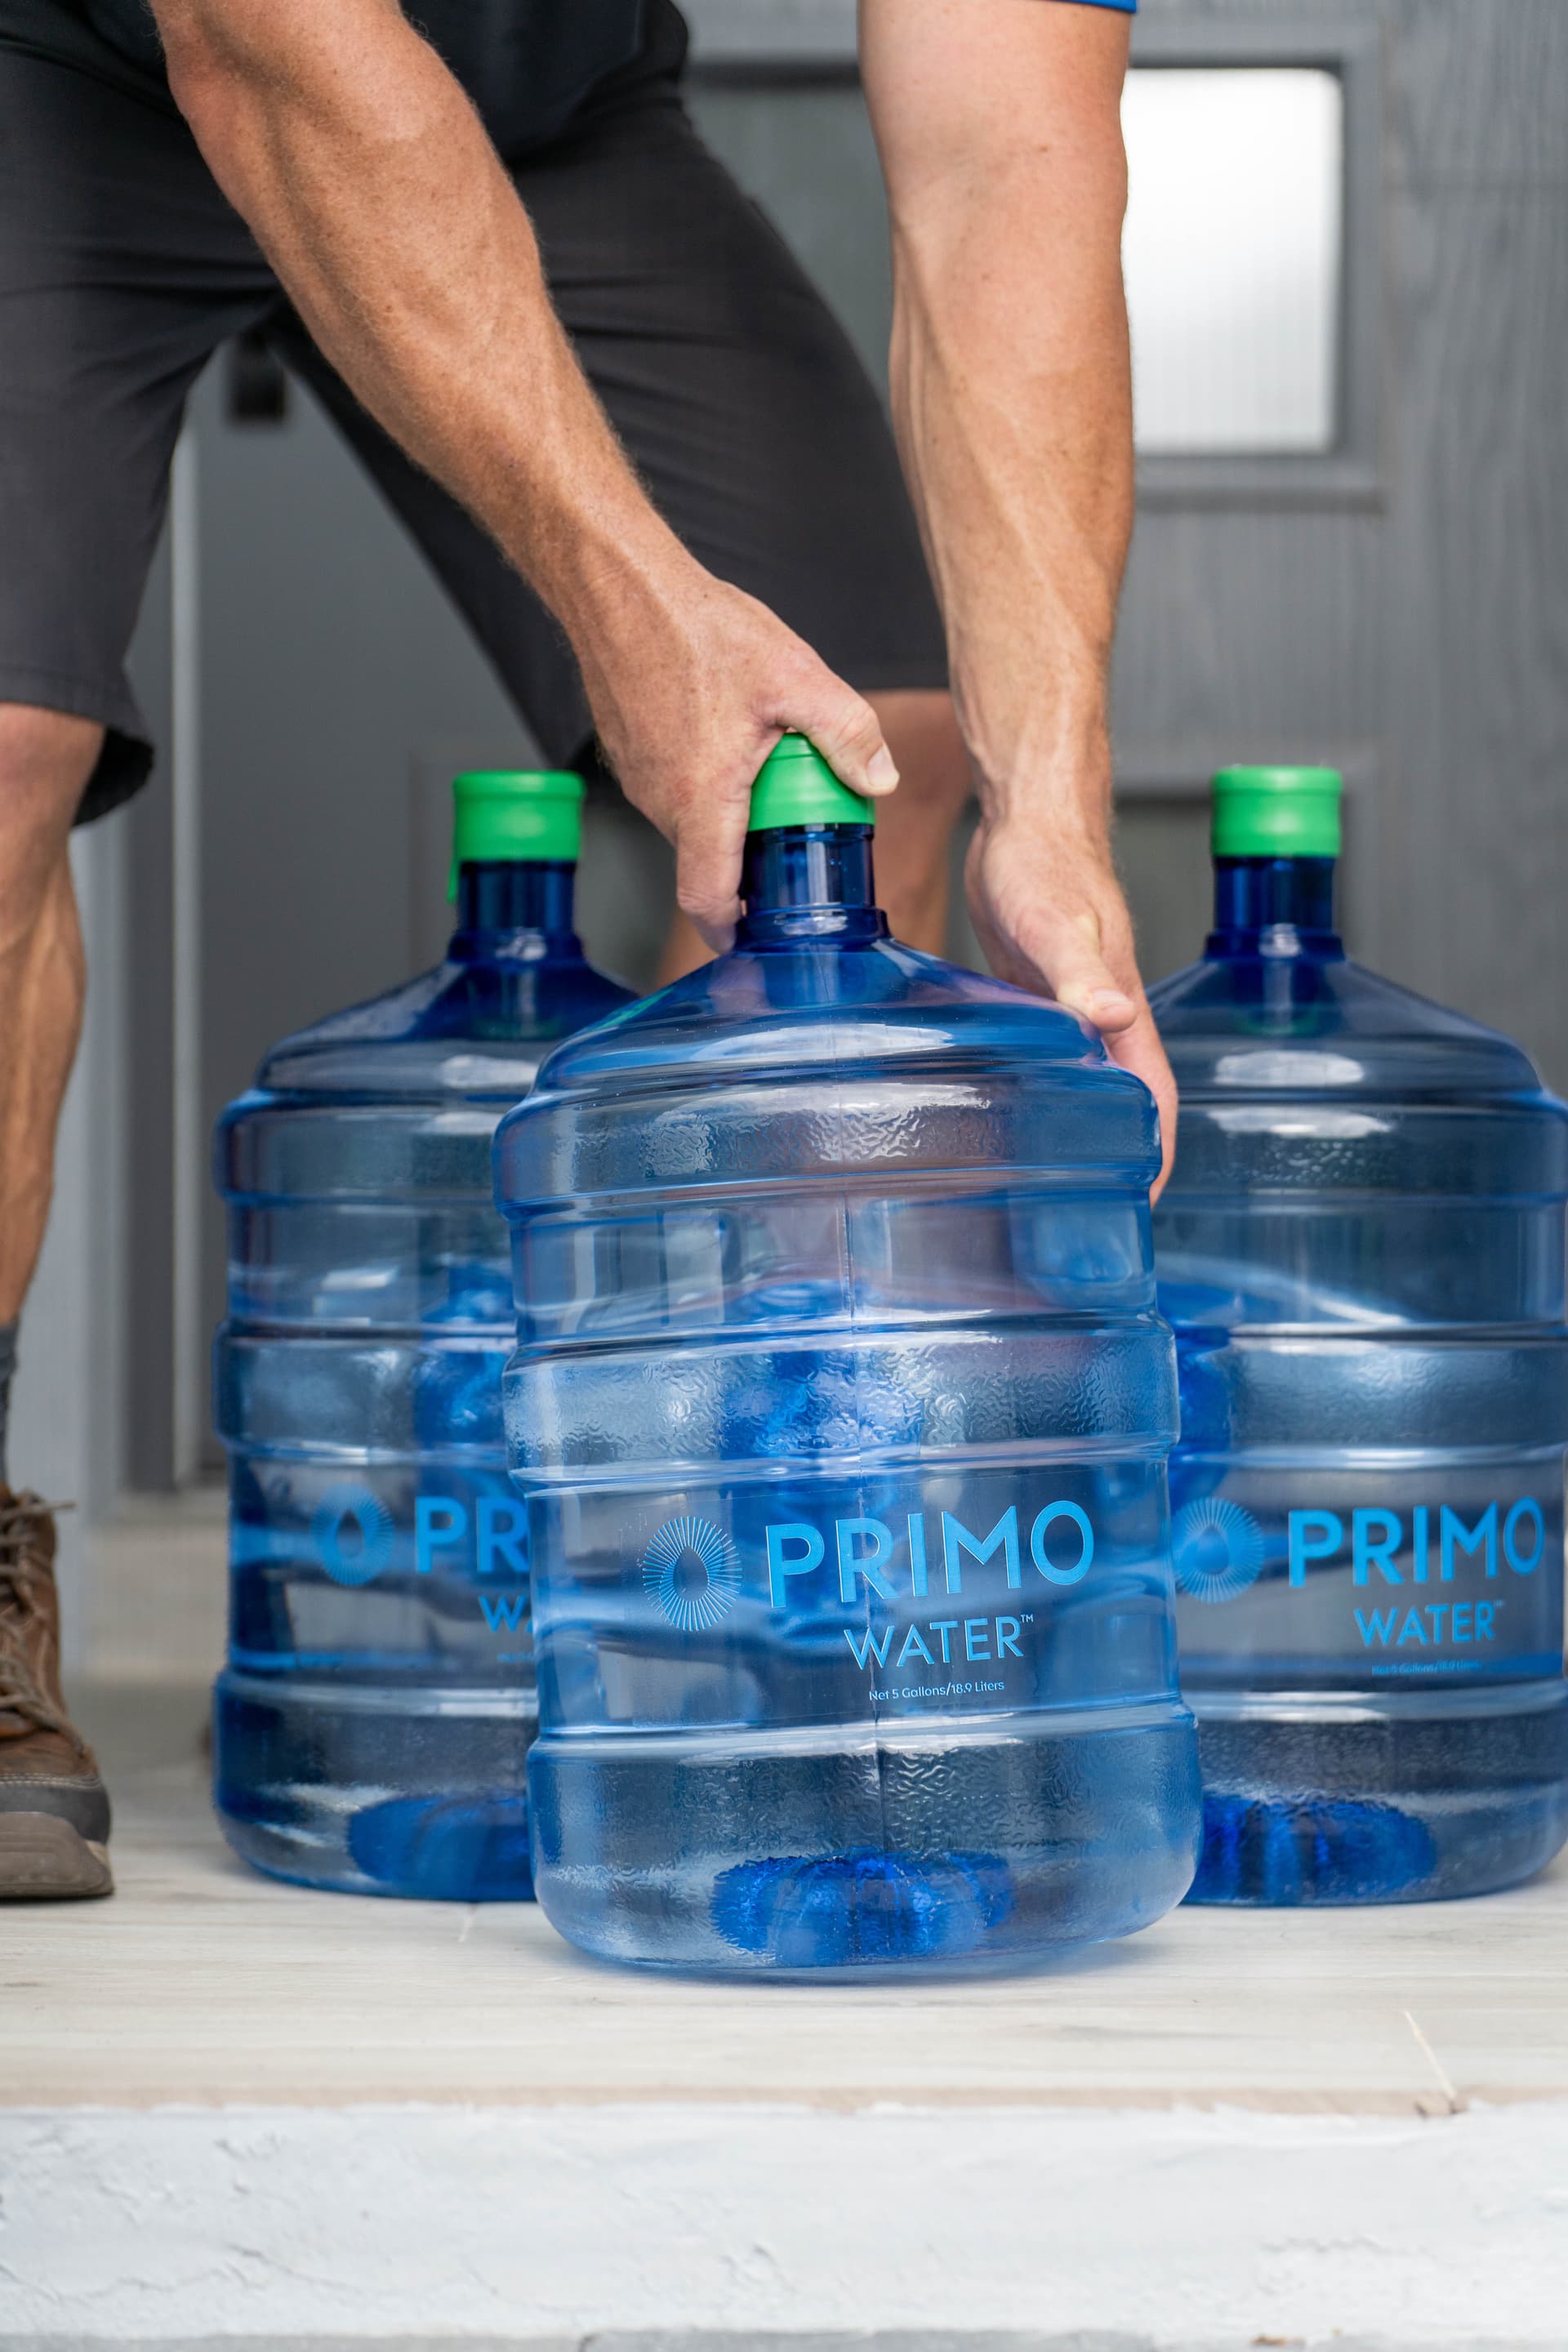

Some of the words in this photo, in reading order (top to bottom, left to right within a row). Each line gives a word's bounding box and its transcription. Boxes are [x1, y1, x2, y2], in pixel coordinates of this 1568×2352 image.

[766, 1499, 1095, 1609] PRIMO
[1289, 1495, 1545, 1588] PRIMO
[869, 1690, 889, 1701] Net
[892, 1689, 899, 1699] 5
[974, 1681, 1005, 1693] Liters
